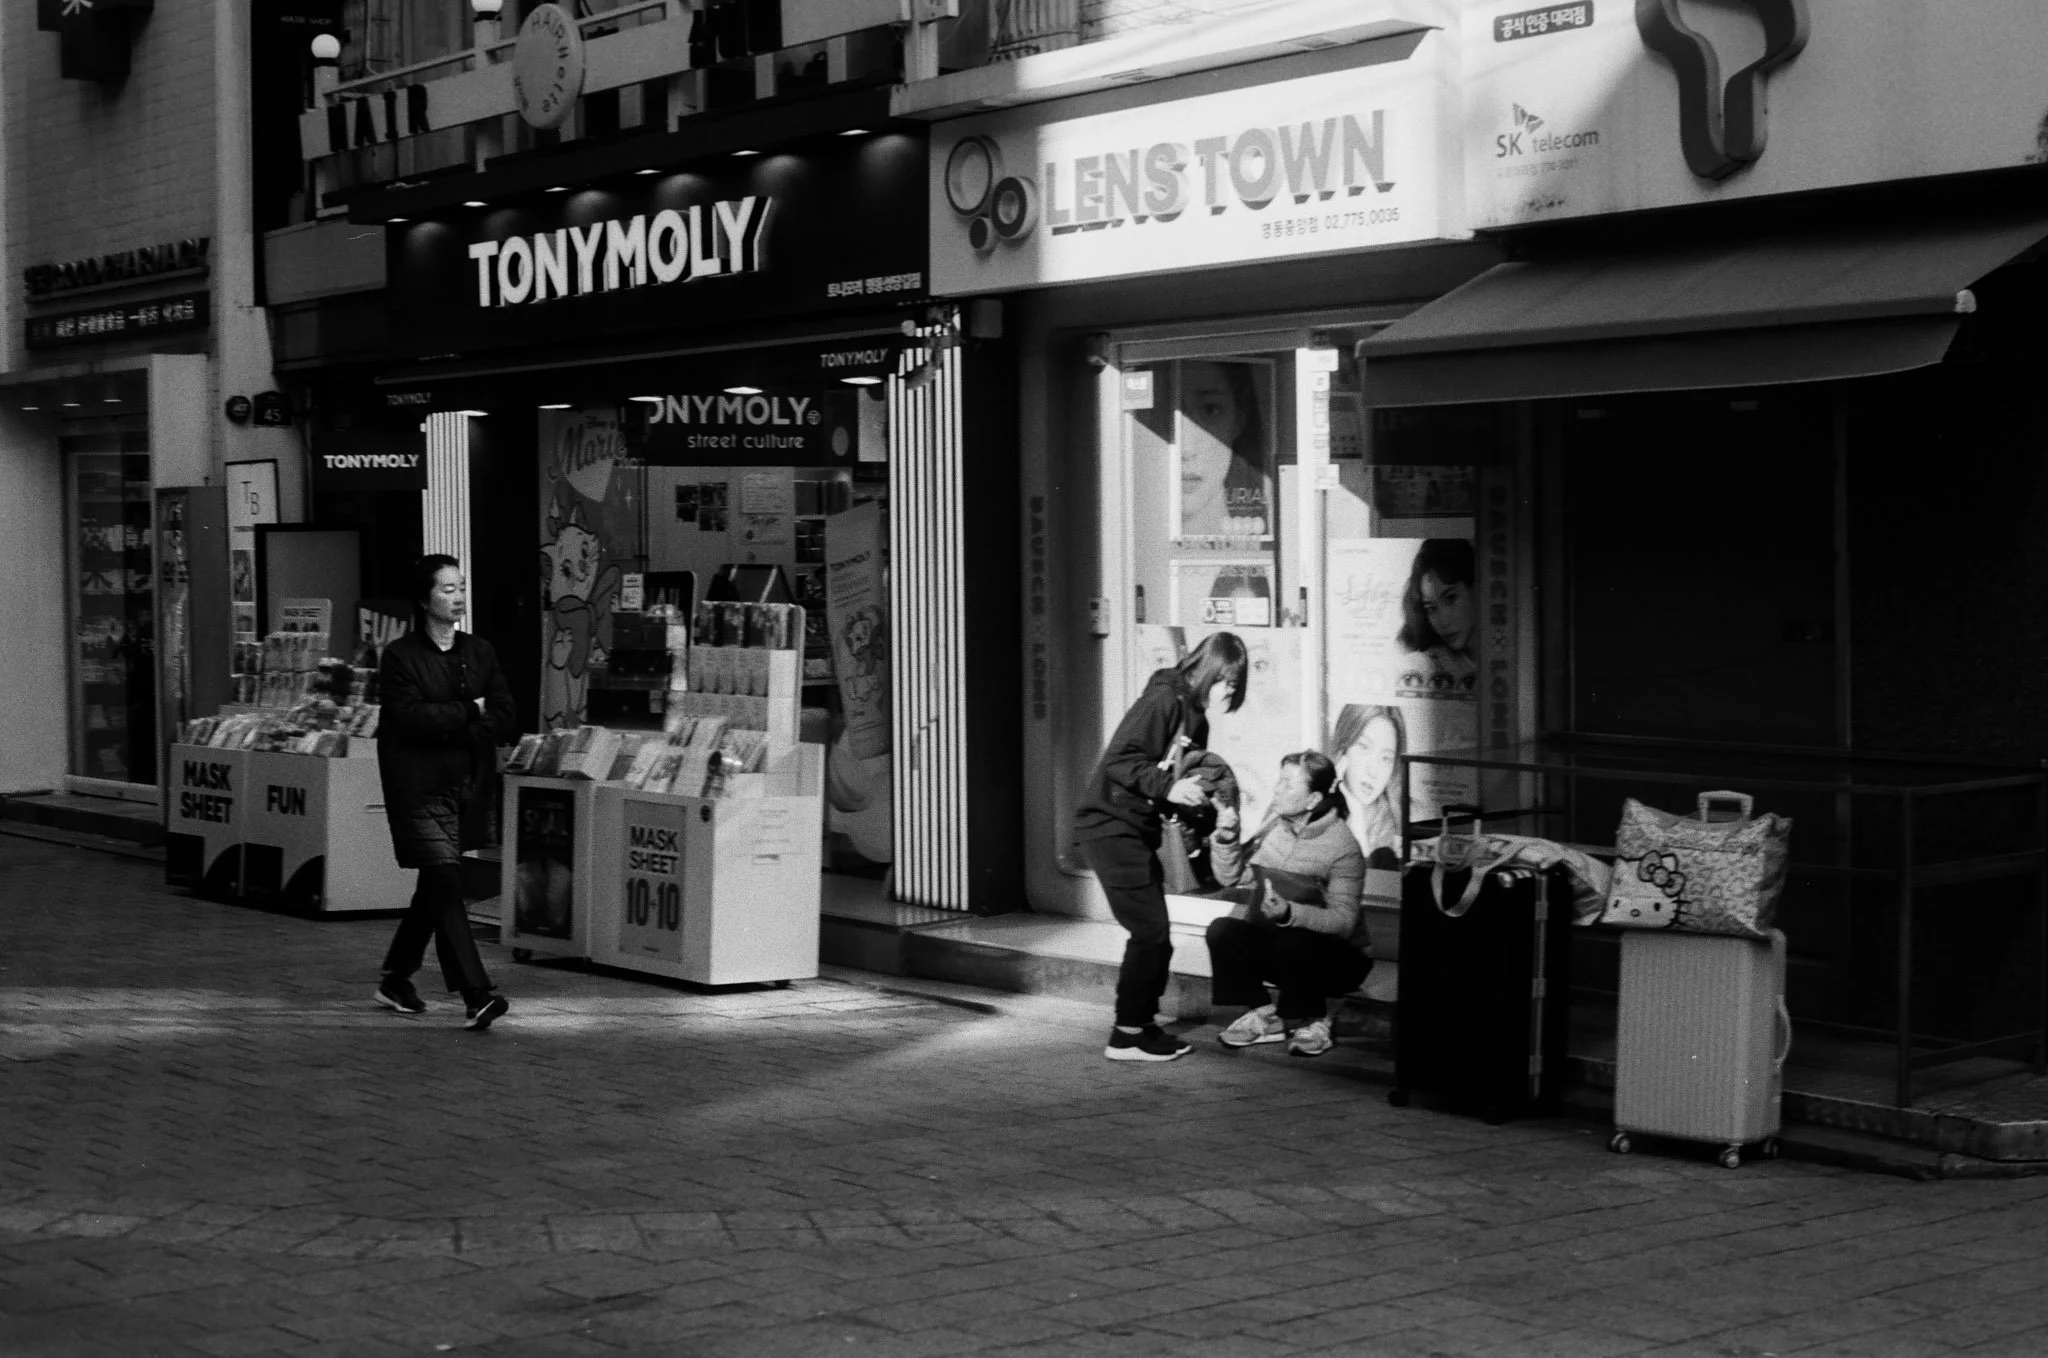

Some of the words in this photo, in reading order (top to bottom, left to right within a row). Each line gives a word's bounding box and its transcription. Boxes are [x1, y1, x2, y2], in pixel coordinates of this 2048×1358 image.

[1500, 17, 1525, 39] 공식
[1525, 12, 1550, 36] 인증
[1496, 132, 1524, 159] SK
[1531, 130, 1600, 154] telecom
[1045, 142, 1190, 236] LENS
[1194, 108, 1396, 217] TOWN
[468, 196, 773, 308] TONYMOLY
[819, 347, 889, 368] TONYMOLY
[687, 433, 738, 449] street
[742, 433, 806, 449] culture
[323, 453, 420, 469] TONYMOLY
[183, 760, 232, 791] MASK
[180, 792, 234, 824] SHEET
[267, 785, 306, 816] FUN
[630, 825, 680, 853] MASK
[628, 851, 679, 875] SHEET
